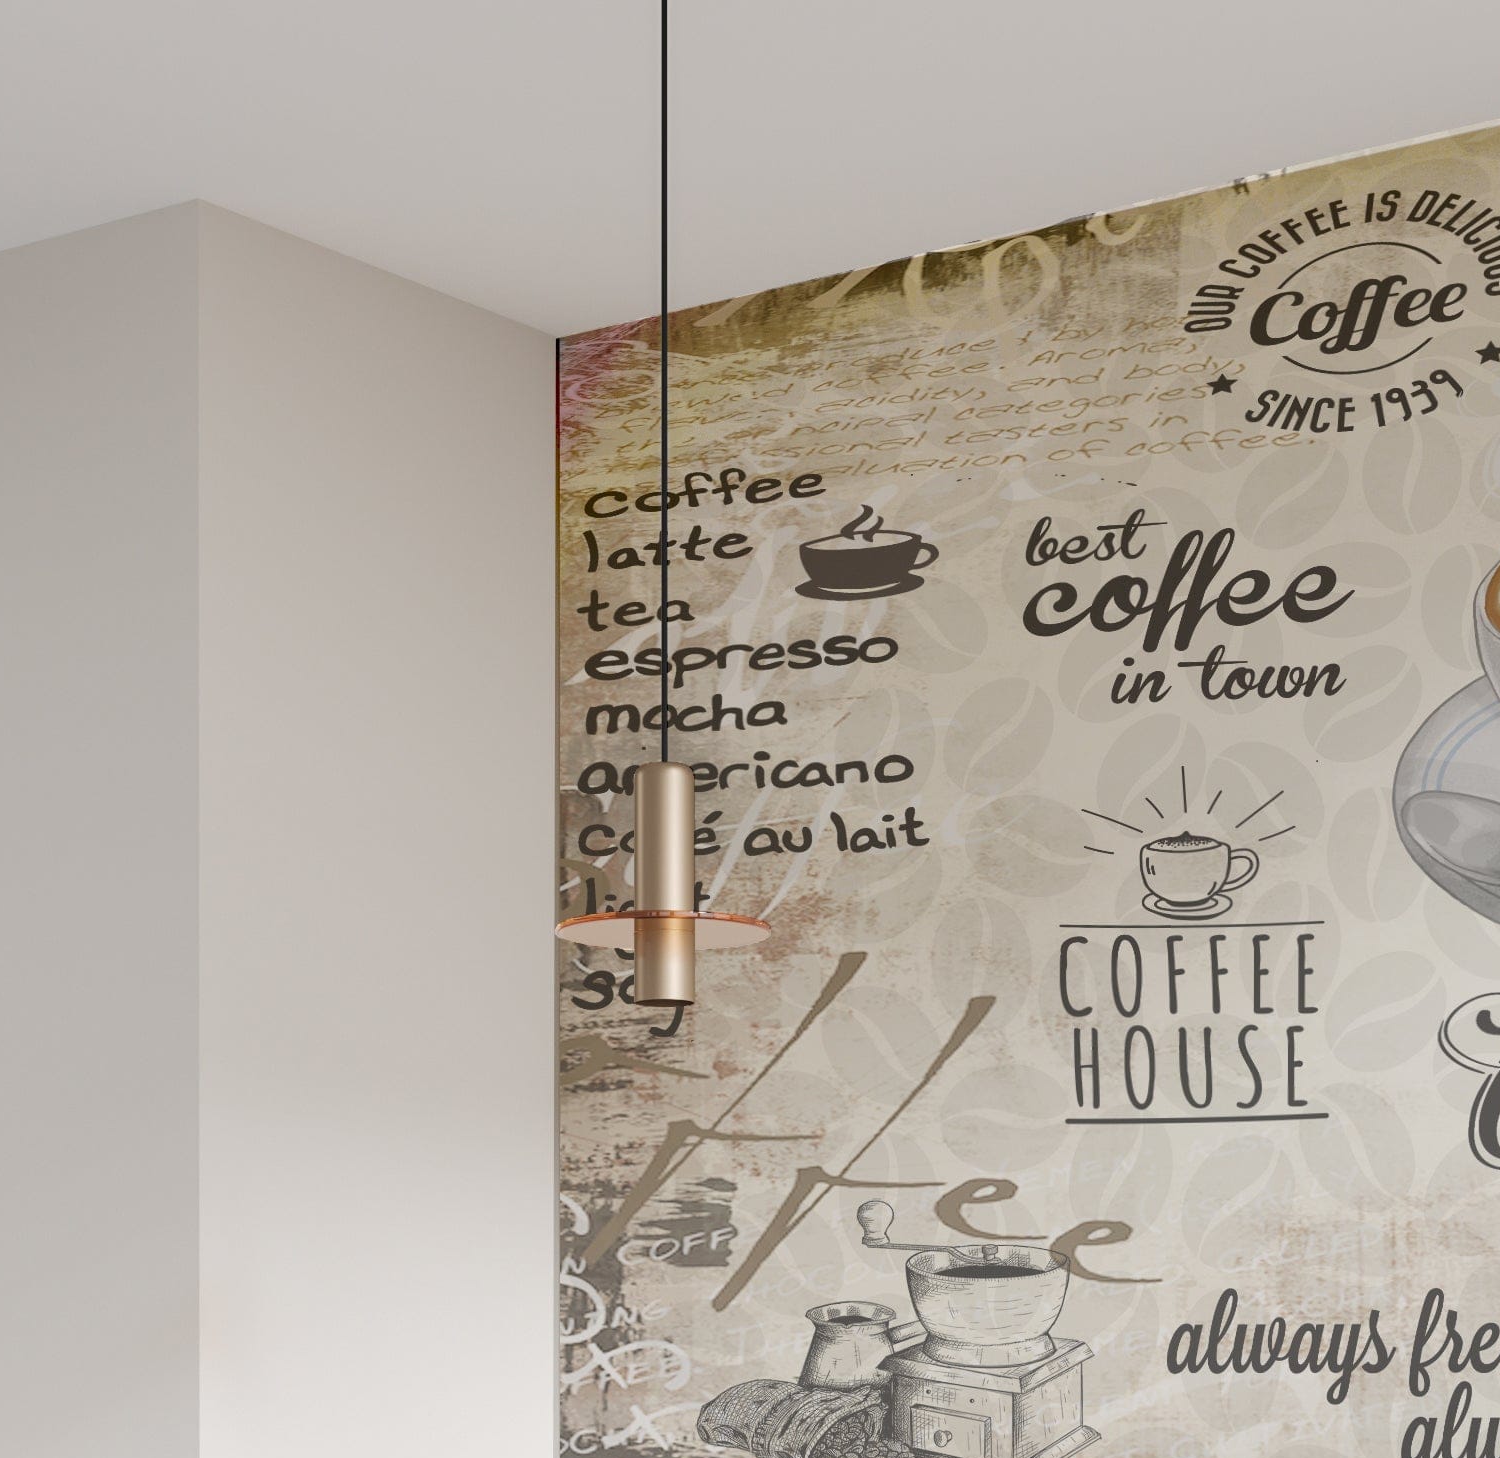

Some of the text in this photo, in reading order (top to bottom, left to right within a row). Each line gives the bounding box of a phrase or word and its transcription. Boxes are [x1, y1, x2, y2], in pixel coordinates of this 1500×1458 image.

[1184, 284, 1245, 333] OUR
[1219, 200, 1350, 279] COFFEE
[1364, 190, 1402, 223] IS
[1250, 275, 1468, 354] Coffee
[1245, 369, 1463, 433] SINCE 1939
[583, 467, 827, 519] coffee
[582, 525, 754, 573] latte
[1024, 508, 1168, 566] best
[577, 589, 696, 633] tea
[1022, 527, 1356, 653] coffee
[584, 634, 899, 689] espresso
[1111, 644, 1348, 705] in town
[585, 693, 788, 735] mocha
[743, 826, 813, 857] au
[830, 806, 931, 854] lait
[1059, 933, 1319, 1018] COFFEE
[1073, 1023, 1308, 1110] HOUSE
[1166, 1287, 1398, 1405] always
